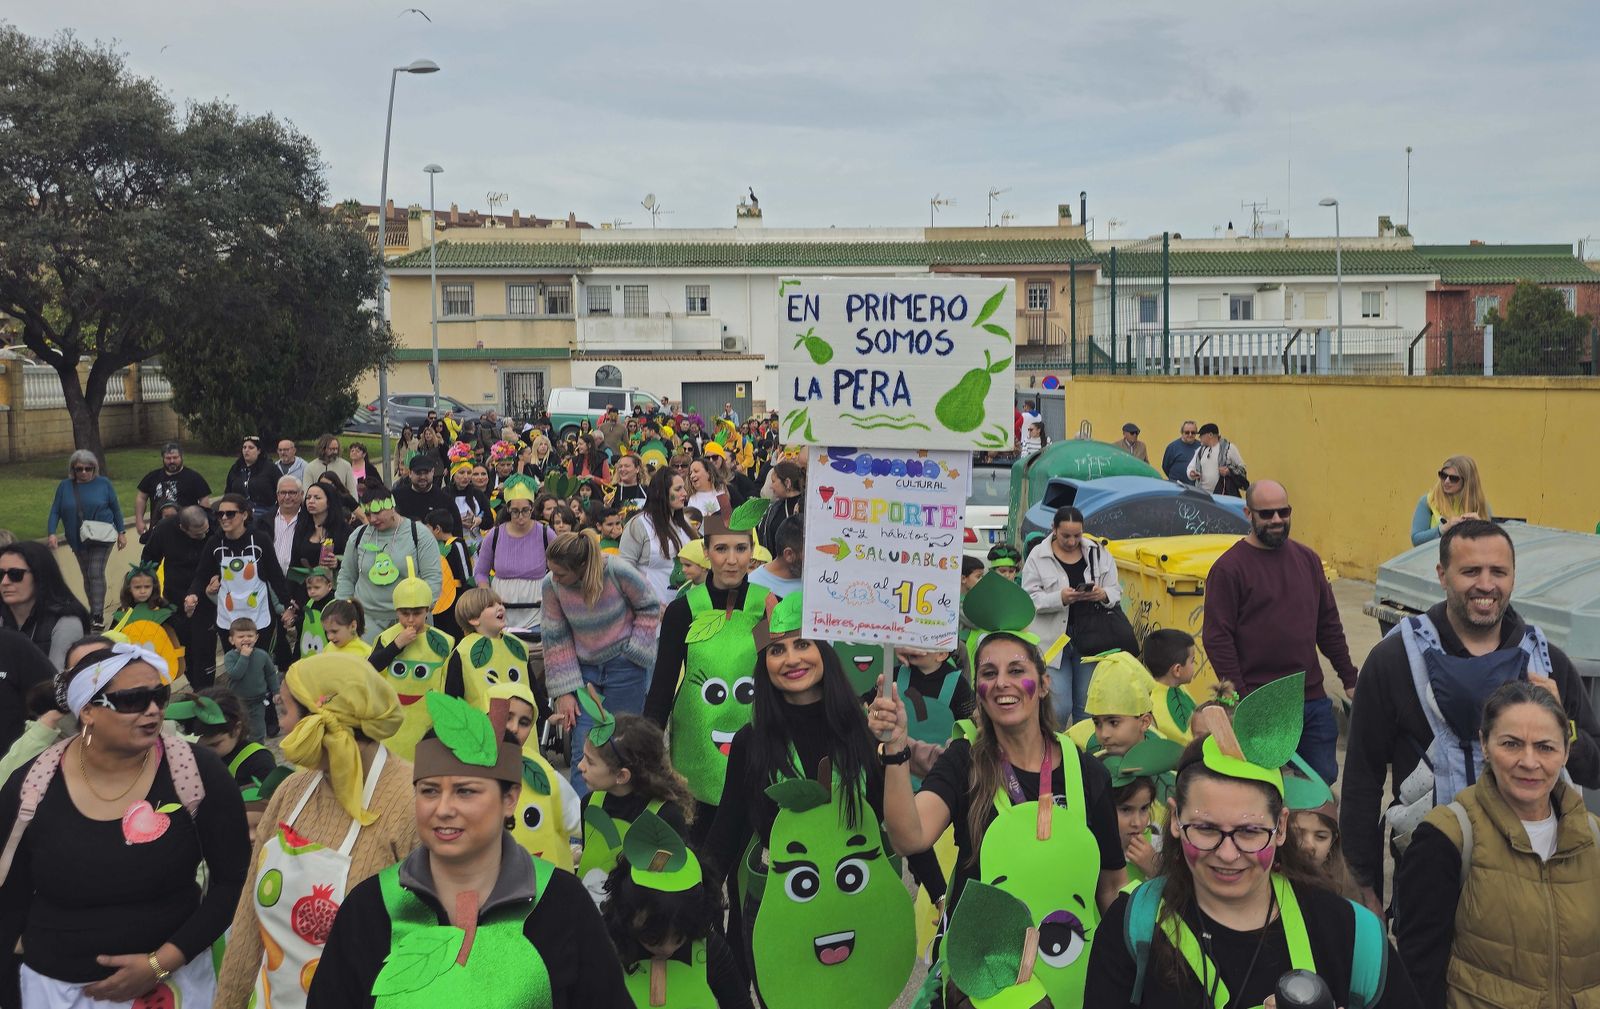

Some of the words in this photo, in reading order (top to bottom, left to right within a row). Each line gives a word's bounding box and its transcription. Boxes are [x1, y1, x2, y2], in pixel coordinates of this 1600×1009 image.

[787, 294, 820, 322] EN
[846, 292, 968, 323] PRIMERO
[855, 327, 955, 356] SOMOS
[794, 376, 823, 402] LA
[833, 368, 912, 410] PERA
[895, 479, 947, 491] CULTURAL
[833, 496, 958, 529] DEPORTE
[880, 527, 929, 541] hábitos
[818, 570, 839, 584] del
[873, 577, 889, 589] al
[892, 580, 938, 615] 16
[938, 593, 951, 607] de
